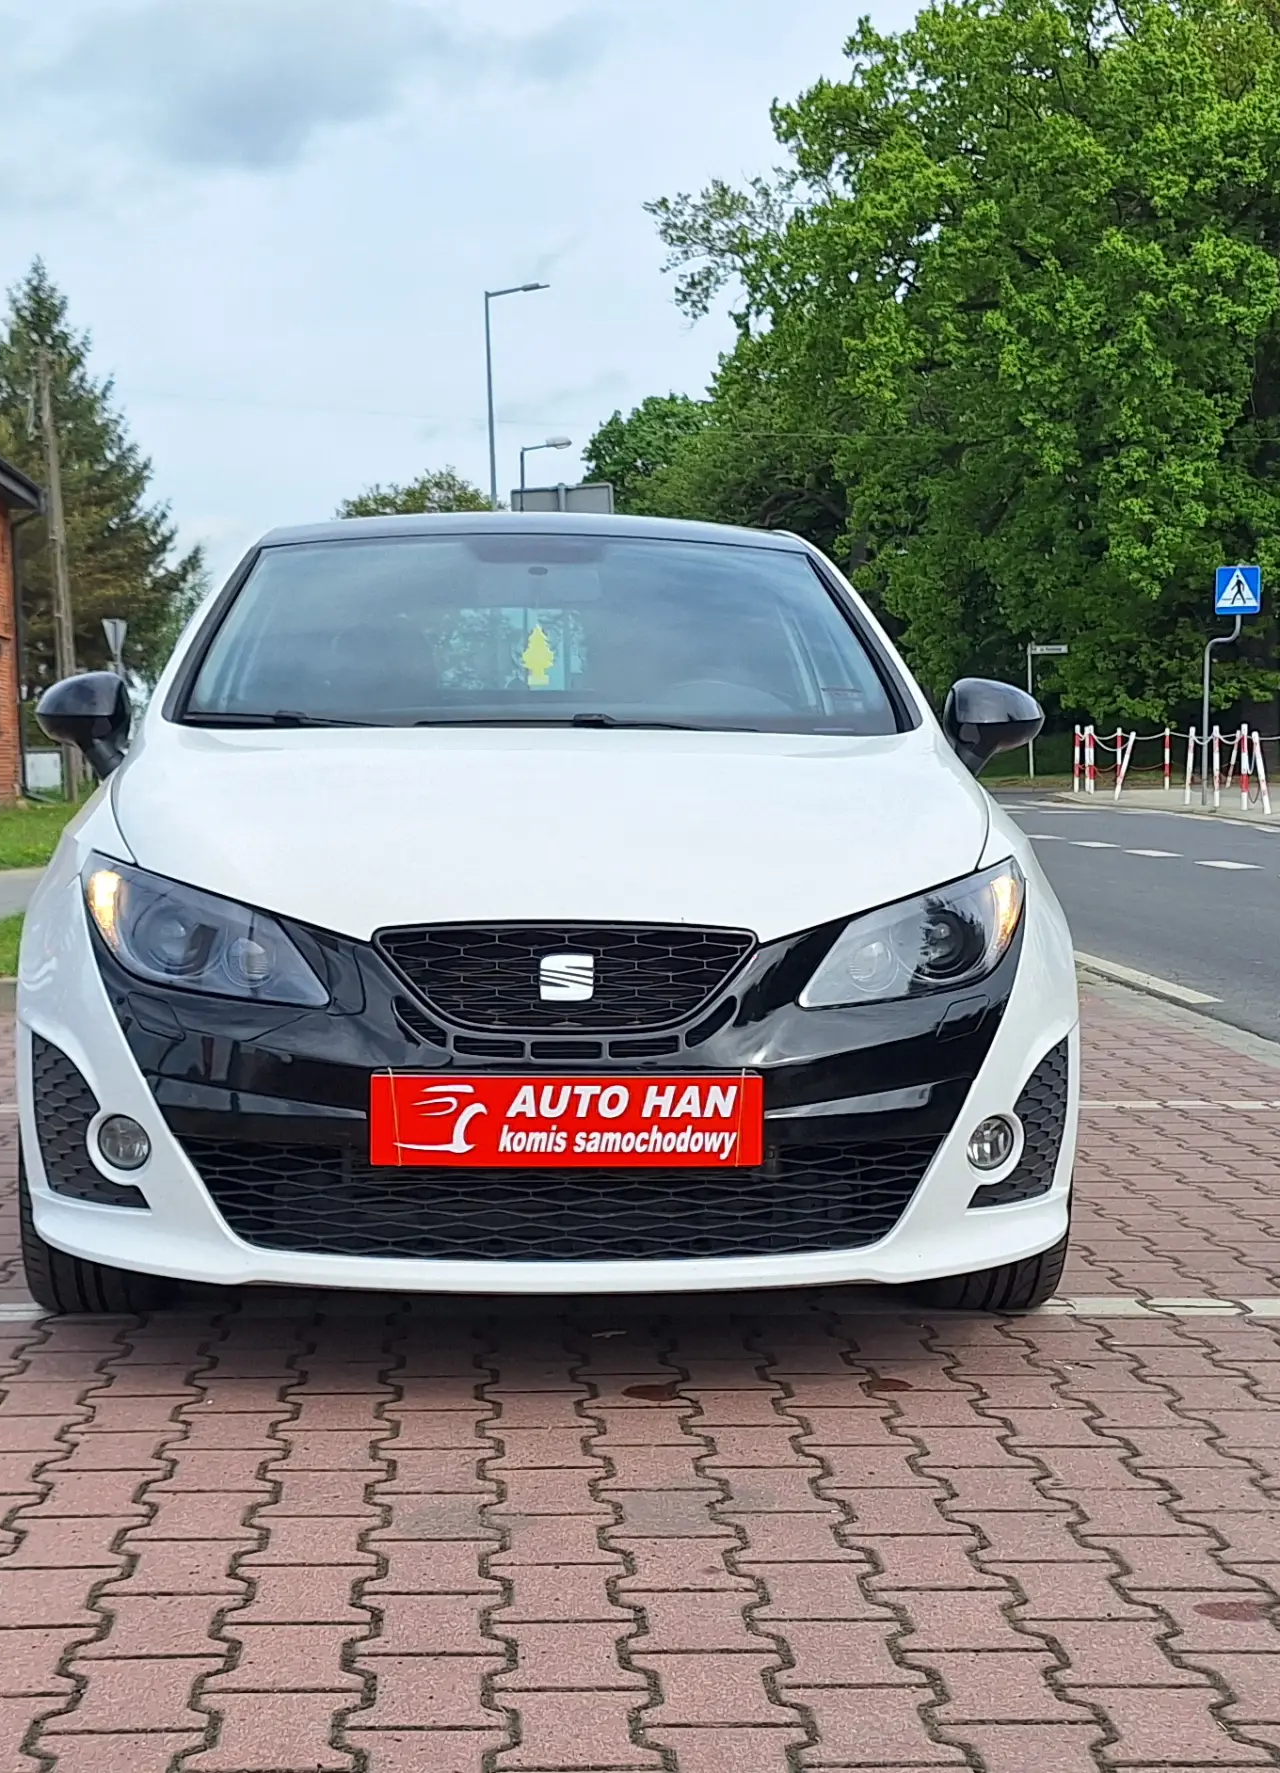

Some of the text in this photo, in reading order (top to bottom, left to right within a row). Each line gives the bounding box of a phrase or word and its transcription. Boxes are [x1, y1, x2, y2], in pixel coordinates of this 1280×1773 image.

[506, 1085, 738, 1118] AUTO HAN
[498, 1124, 738, 1160] komis samochodowy
